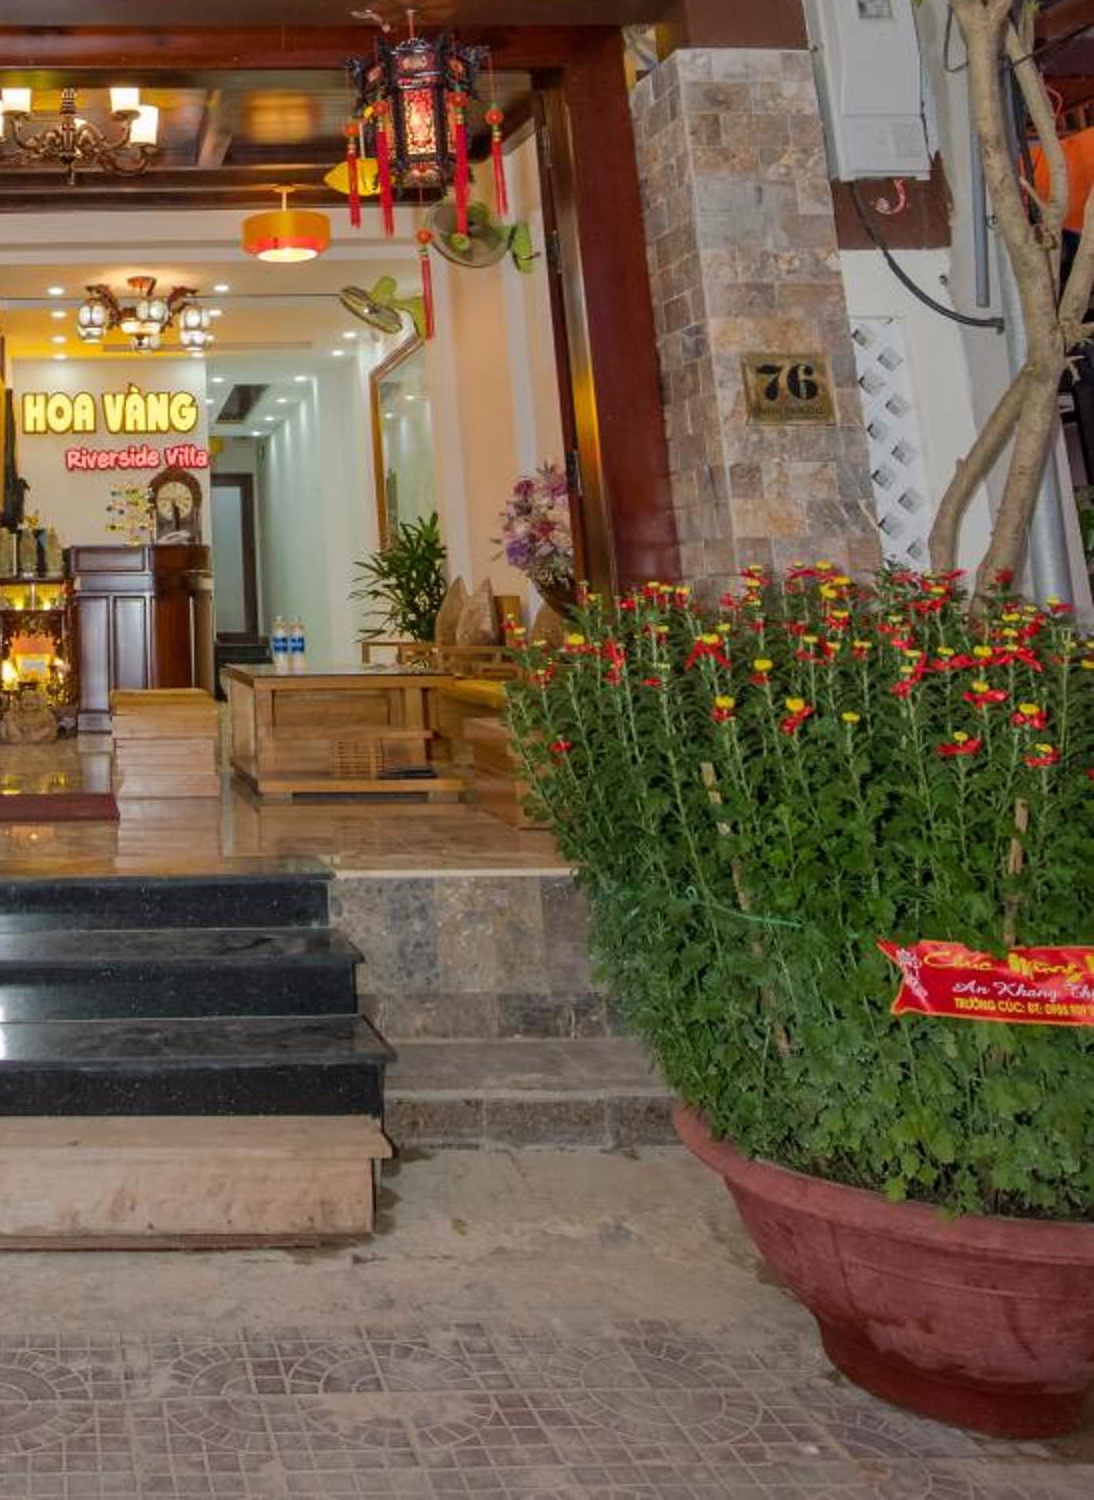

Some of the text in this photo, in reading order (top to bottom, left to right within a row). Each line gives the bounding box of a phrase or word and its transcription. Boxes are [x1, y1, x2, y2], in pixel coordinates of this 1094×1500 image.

[755, 363, 818, 401] 76
[22, 384, 199, 434] HOA VÀNG
[66, 443, 210, 471] Riverside Villa
